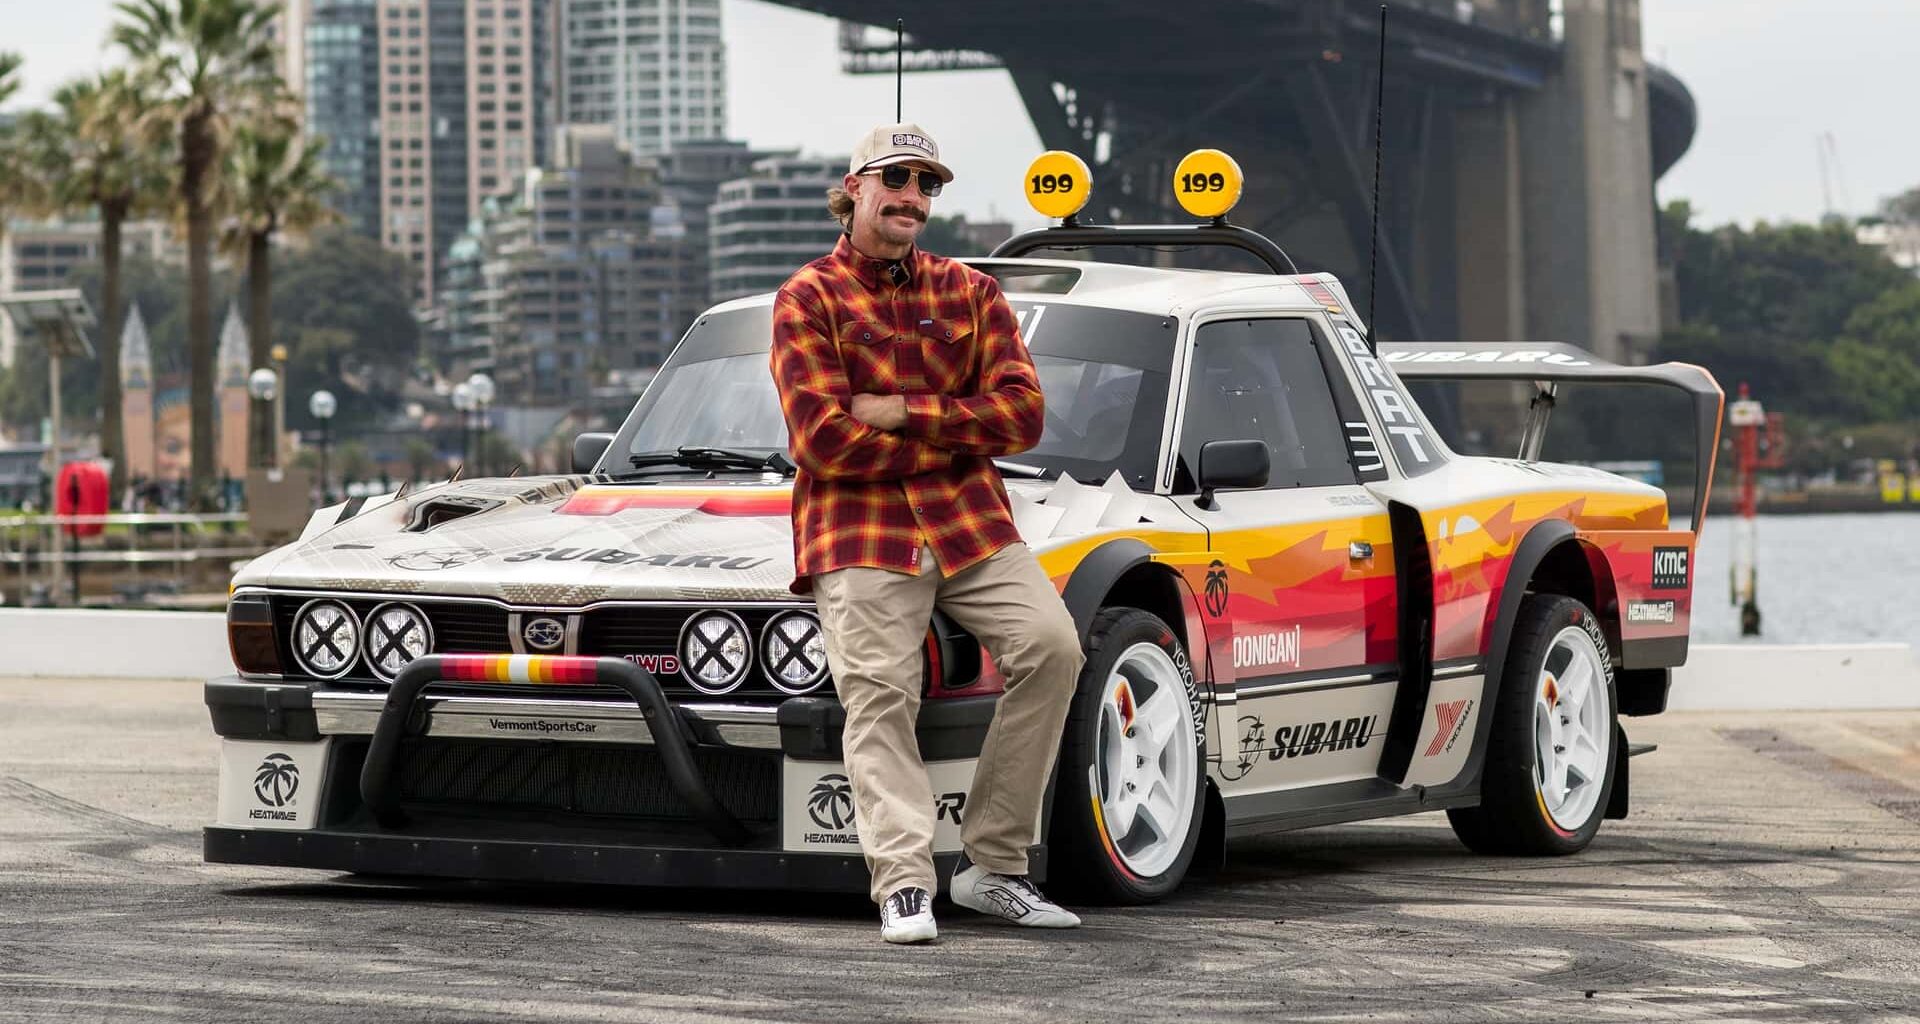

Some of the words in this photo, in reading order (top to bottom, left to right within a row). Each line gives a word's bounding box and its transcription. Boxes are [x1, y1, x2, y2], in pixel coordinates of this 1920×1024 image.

[1031, 174, 1074, 194] 199
[1182, 172, 1225, 193] 199
[1384, 350, 1592, 366] UBARU
[1338, 326, 1430, 463] BRAT
[503, 547, 774, 570] SUBARU
[1654, 551, 1687, 575] KMC
[1582, 611, 1615, 685] YOKOHAMA
[1171, 641, 1206, 747] YOKOHAMA
[489, 718, 597, 733] VermontSportsCar
[1268, 714, 1378, 762] SUBARU
[249, 809, 297, 821] HEATWAVE
[804, 833, 860, 844] HEATWAVE
